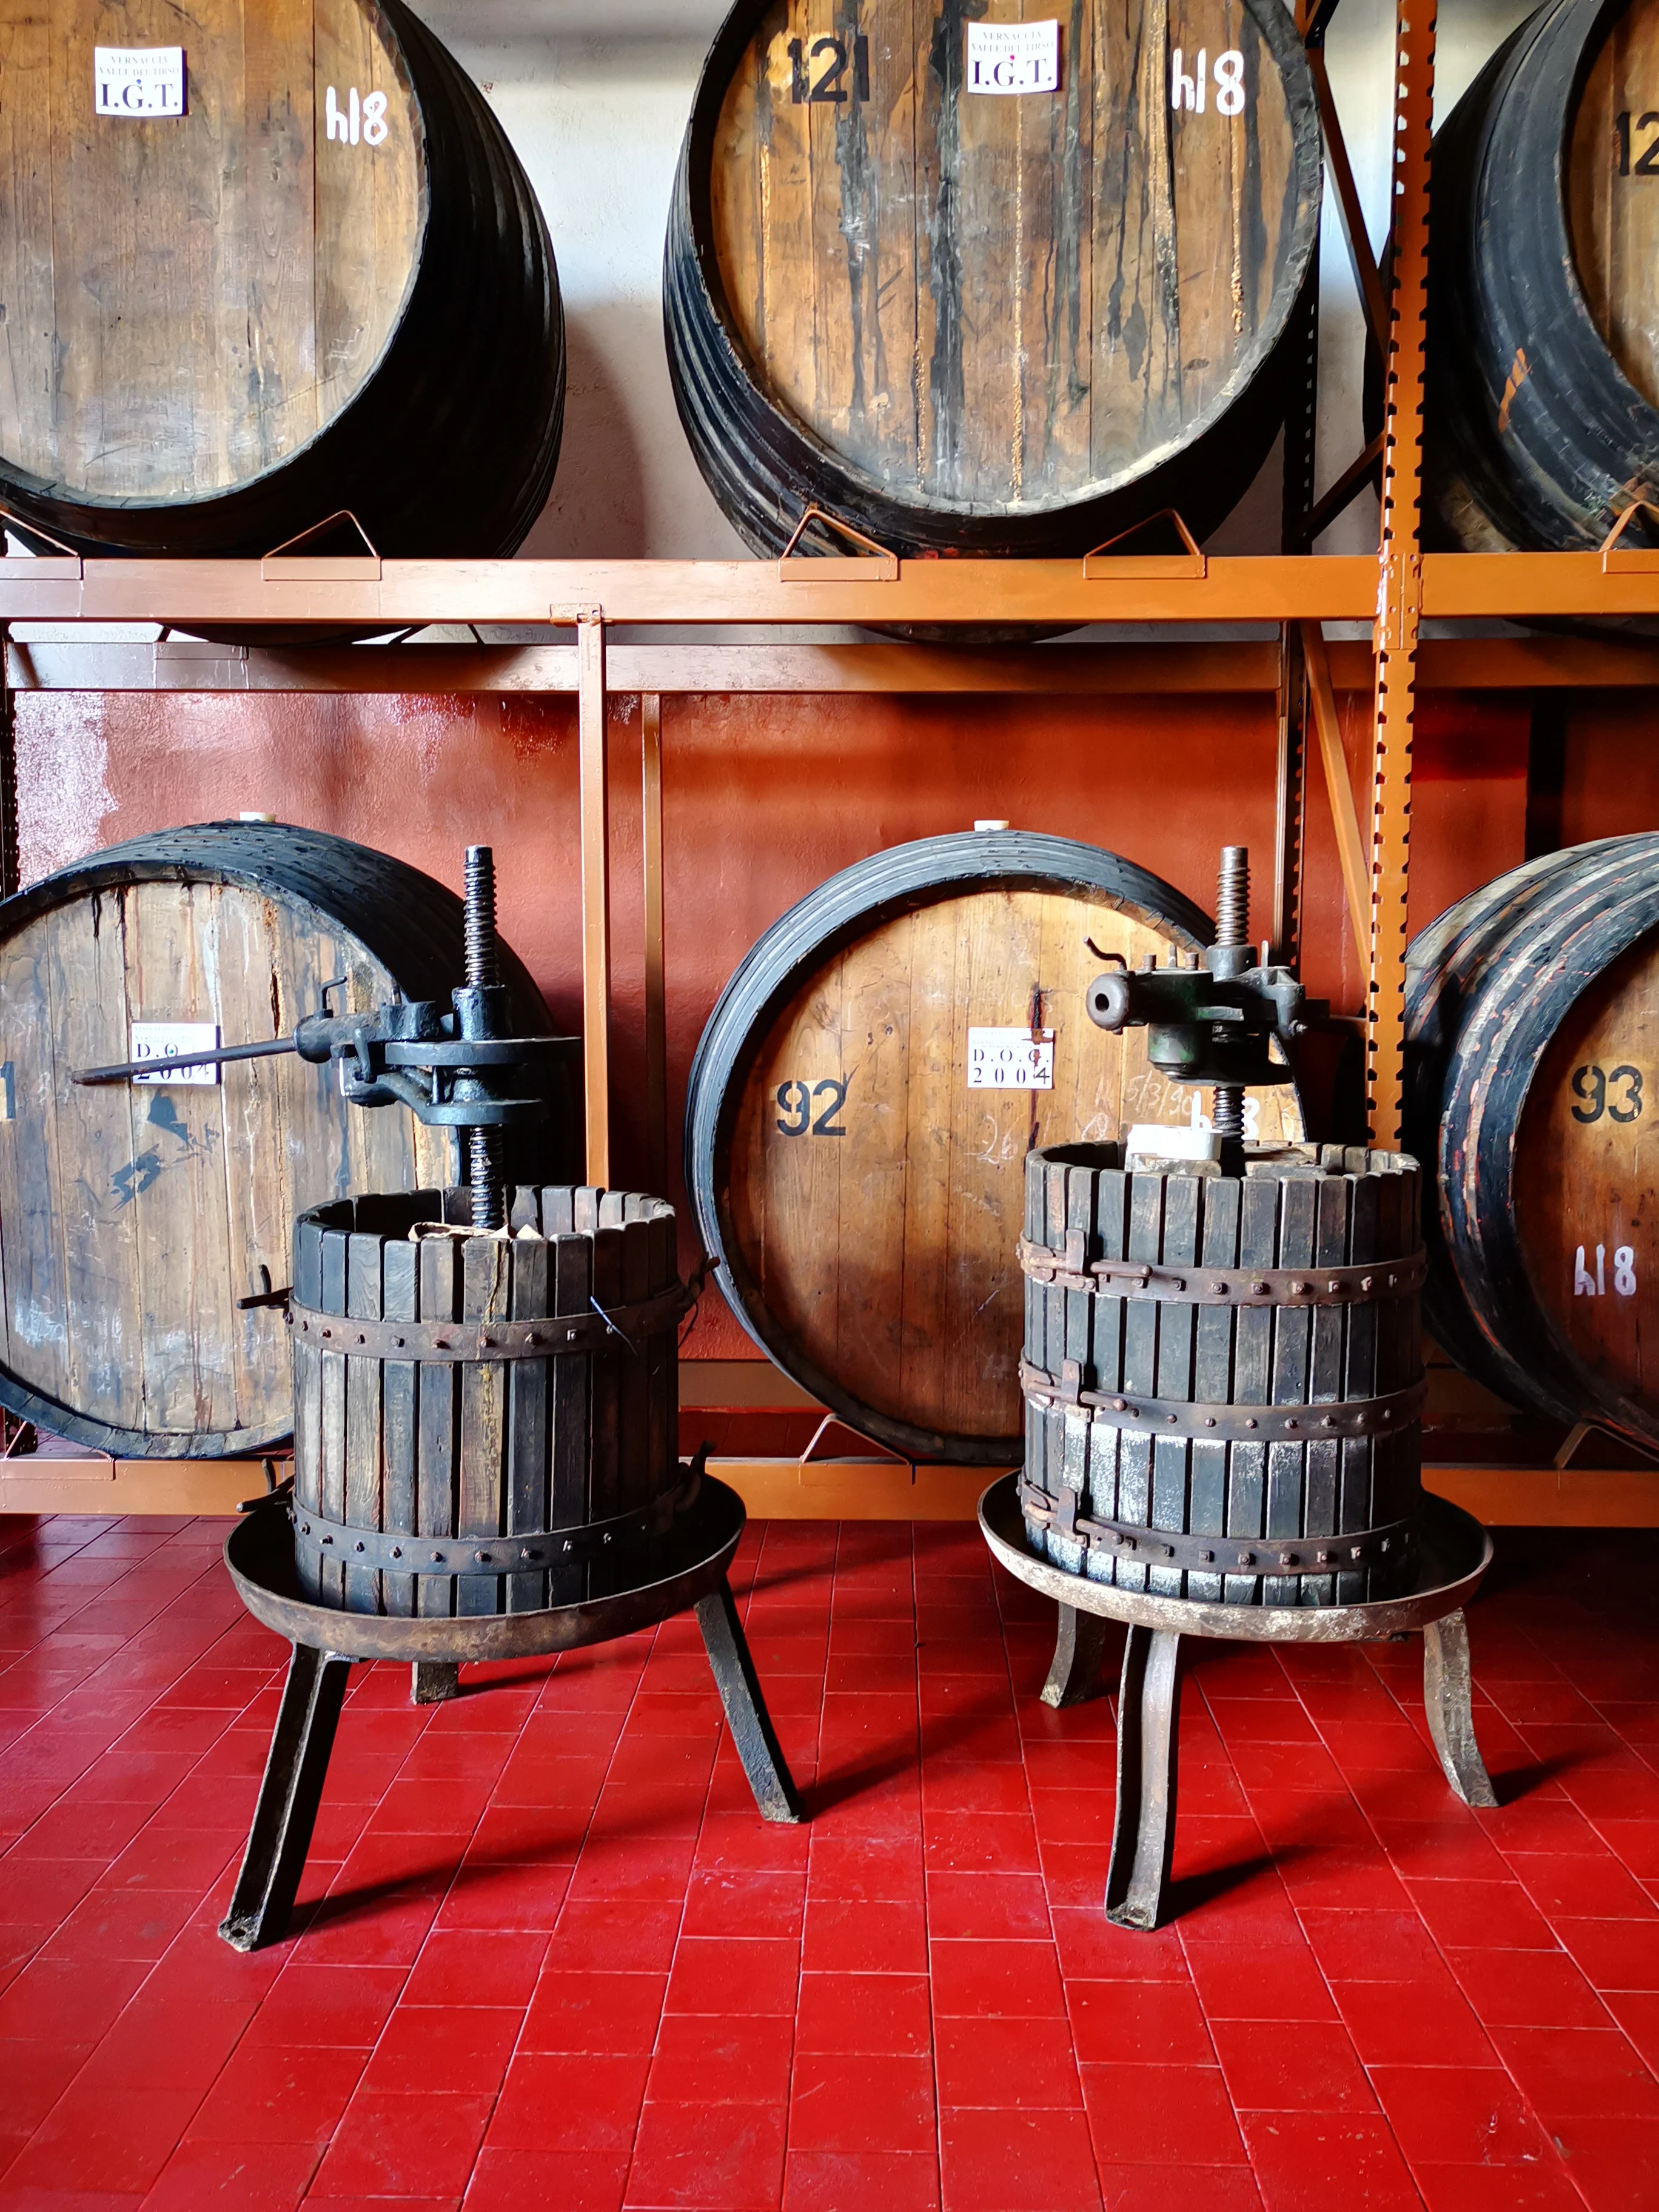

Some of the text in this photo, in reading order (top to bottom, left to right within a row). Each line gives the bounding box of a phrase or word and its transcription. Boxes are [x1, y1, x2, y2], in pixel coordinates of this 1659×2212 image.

[983, 31, 1042, 41] VERNACCIA
[971, 43, 1001, 52] VALLE
[1026, 41, 1054, 51] TIRSO
[111, 56, 168, 64] VERNACCIA
[99, 67, 179, 76] VALLE DEL TIRSO
[971, 58, 1052, 86] I.G.T.
[99, 83, 178, 109] I.G.T.
[1571, 1065, 1643, 1123] 93
[777, 1079, 846, 1137] 92
